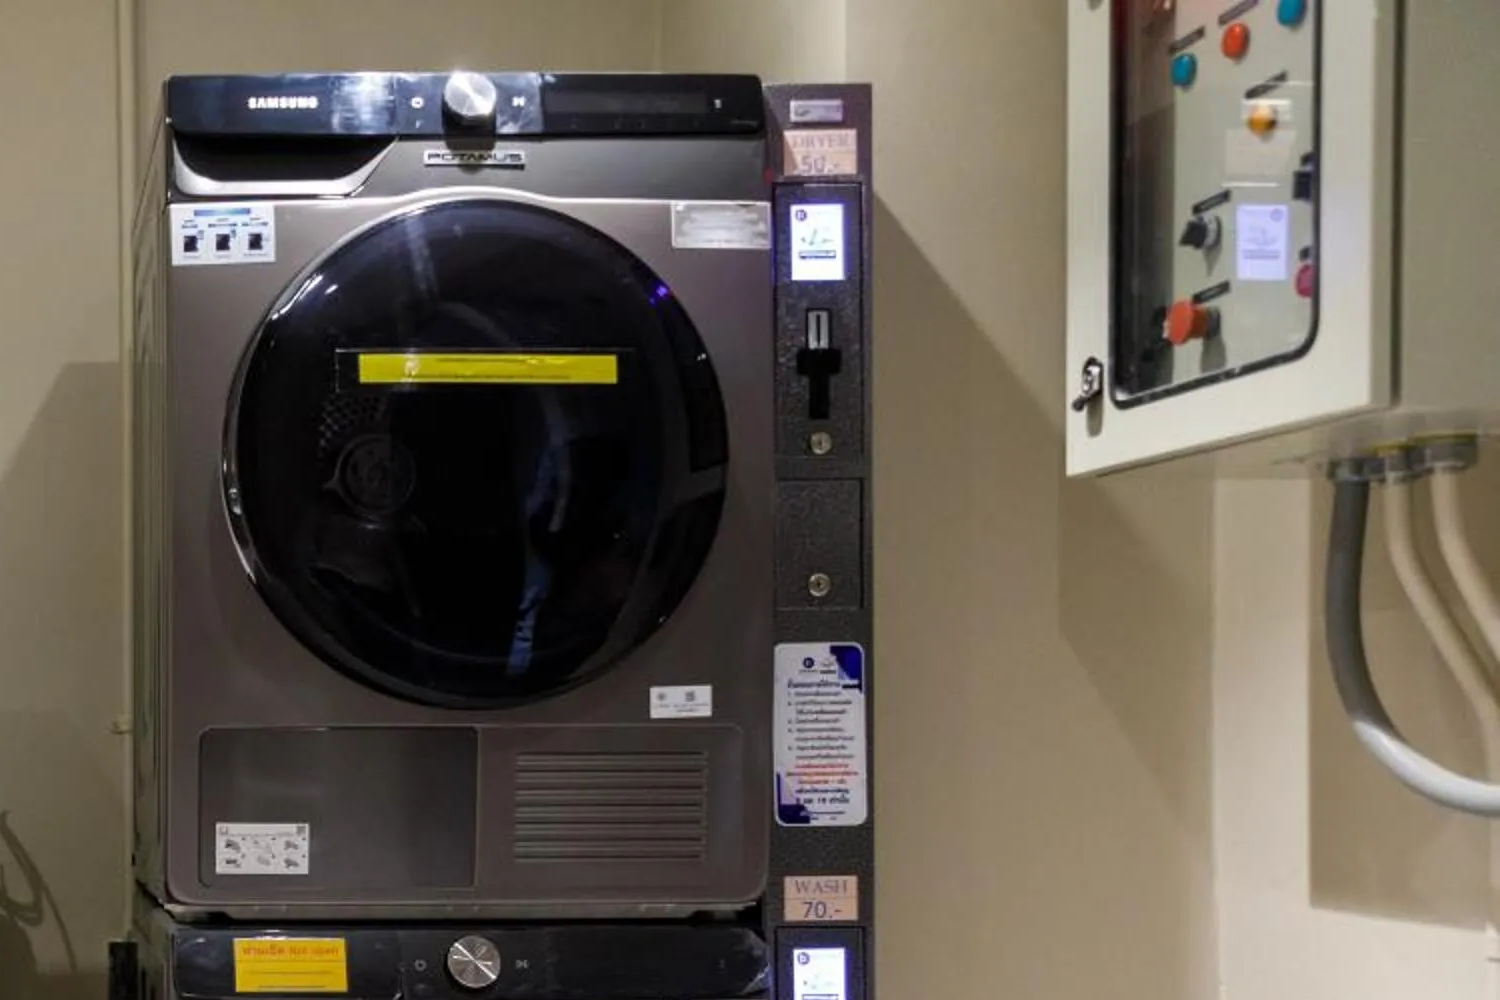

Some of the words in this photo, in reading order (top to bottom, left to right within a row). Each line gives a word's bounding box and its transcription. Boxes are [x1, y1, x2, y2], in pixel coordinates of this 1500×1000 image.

[248, 96, 319, 109] SAMSUNG
[426, 152, 523, 163] POTAMUS
[795, 879, 848, 894] WASH
